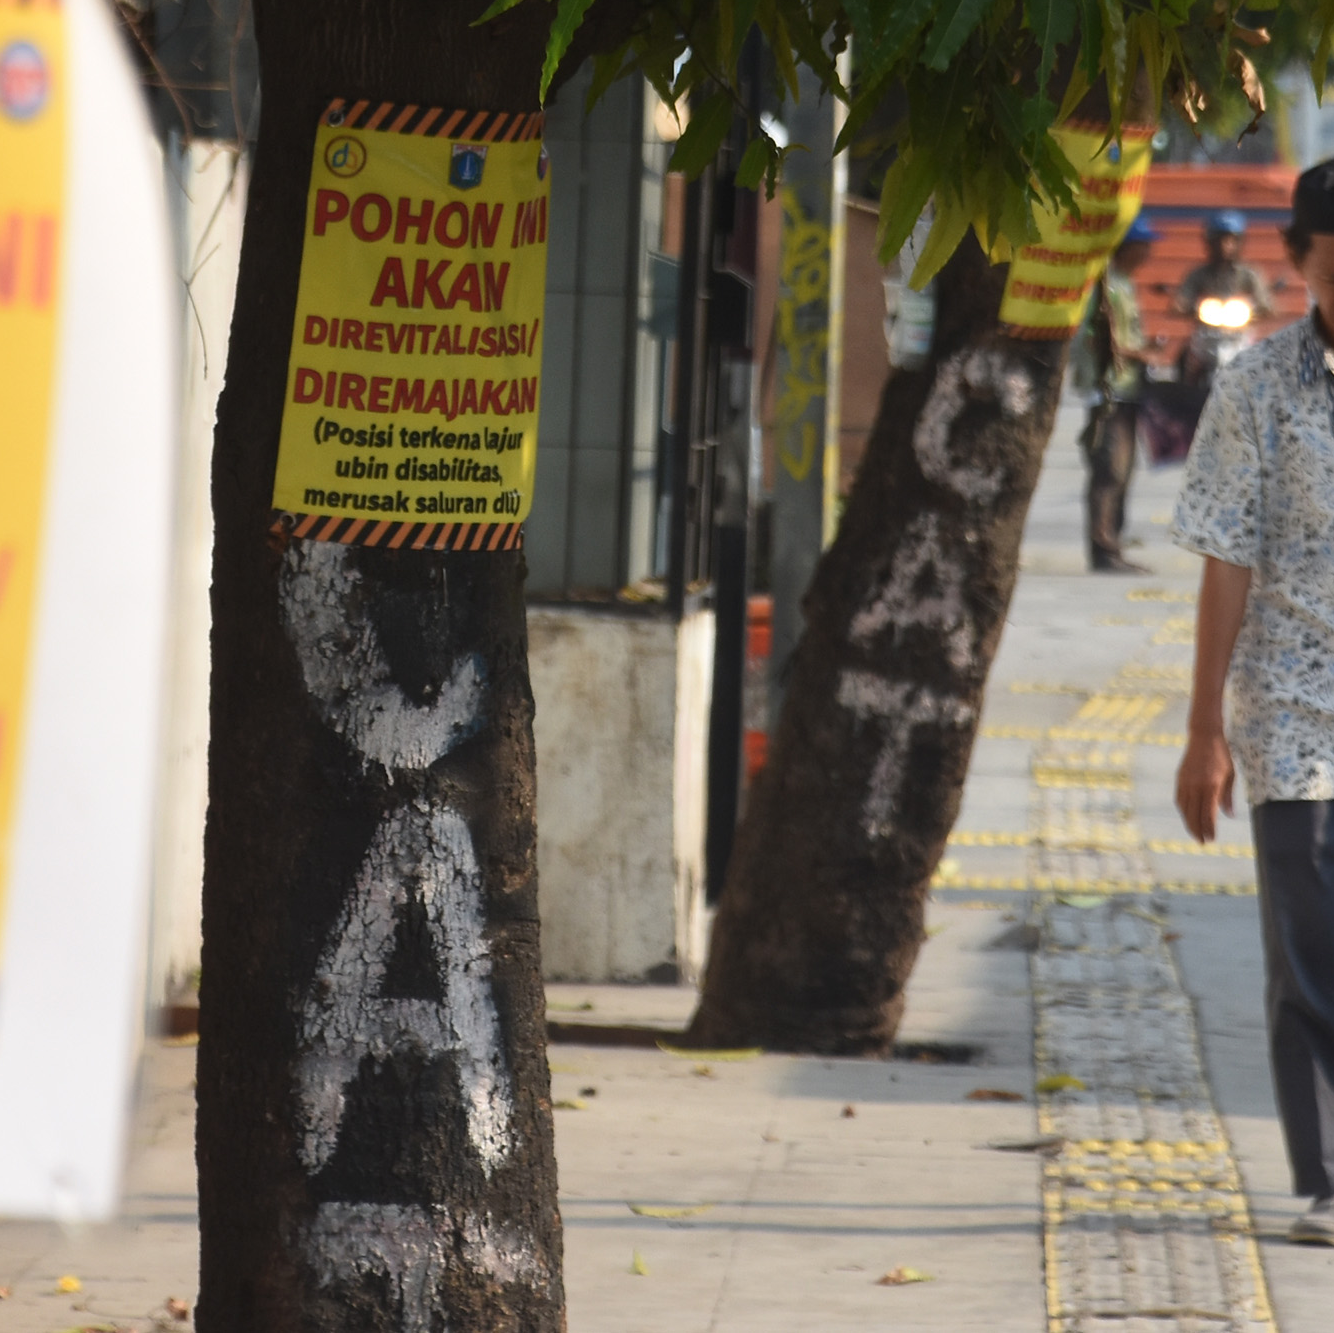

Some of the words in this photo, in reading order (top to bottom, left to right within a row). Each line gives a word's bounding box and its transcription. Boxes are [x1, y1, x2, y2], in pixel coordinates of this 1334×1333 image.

[312, 188, 504, 249] POHON
[510, 195, 547, 249] INI
[369, 257, 510, 313] AKAN
[302, 315, 540, 358] DIREVITALISASI/
[292, 367, 538, 421] DIREMAJAKAN
[313, 416, 394, 448] (Posisi
[399, 426, 481, 451] terkena
[484, 426, 524, 455] lajur
[335, 456, 389, 480] ubin
[394, 457, 503, 486] disabilitas,
[303, 487, 410, 513] merusak
[415, 491, 487, 515] saluran
